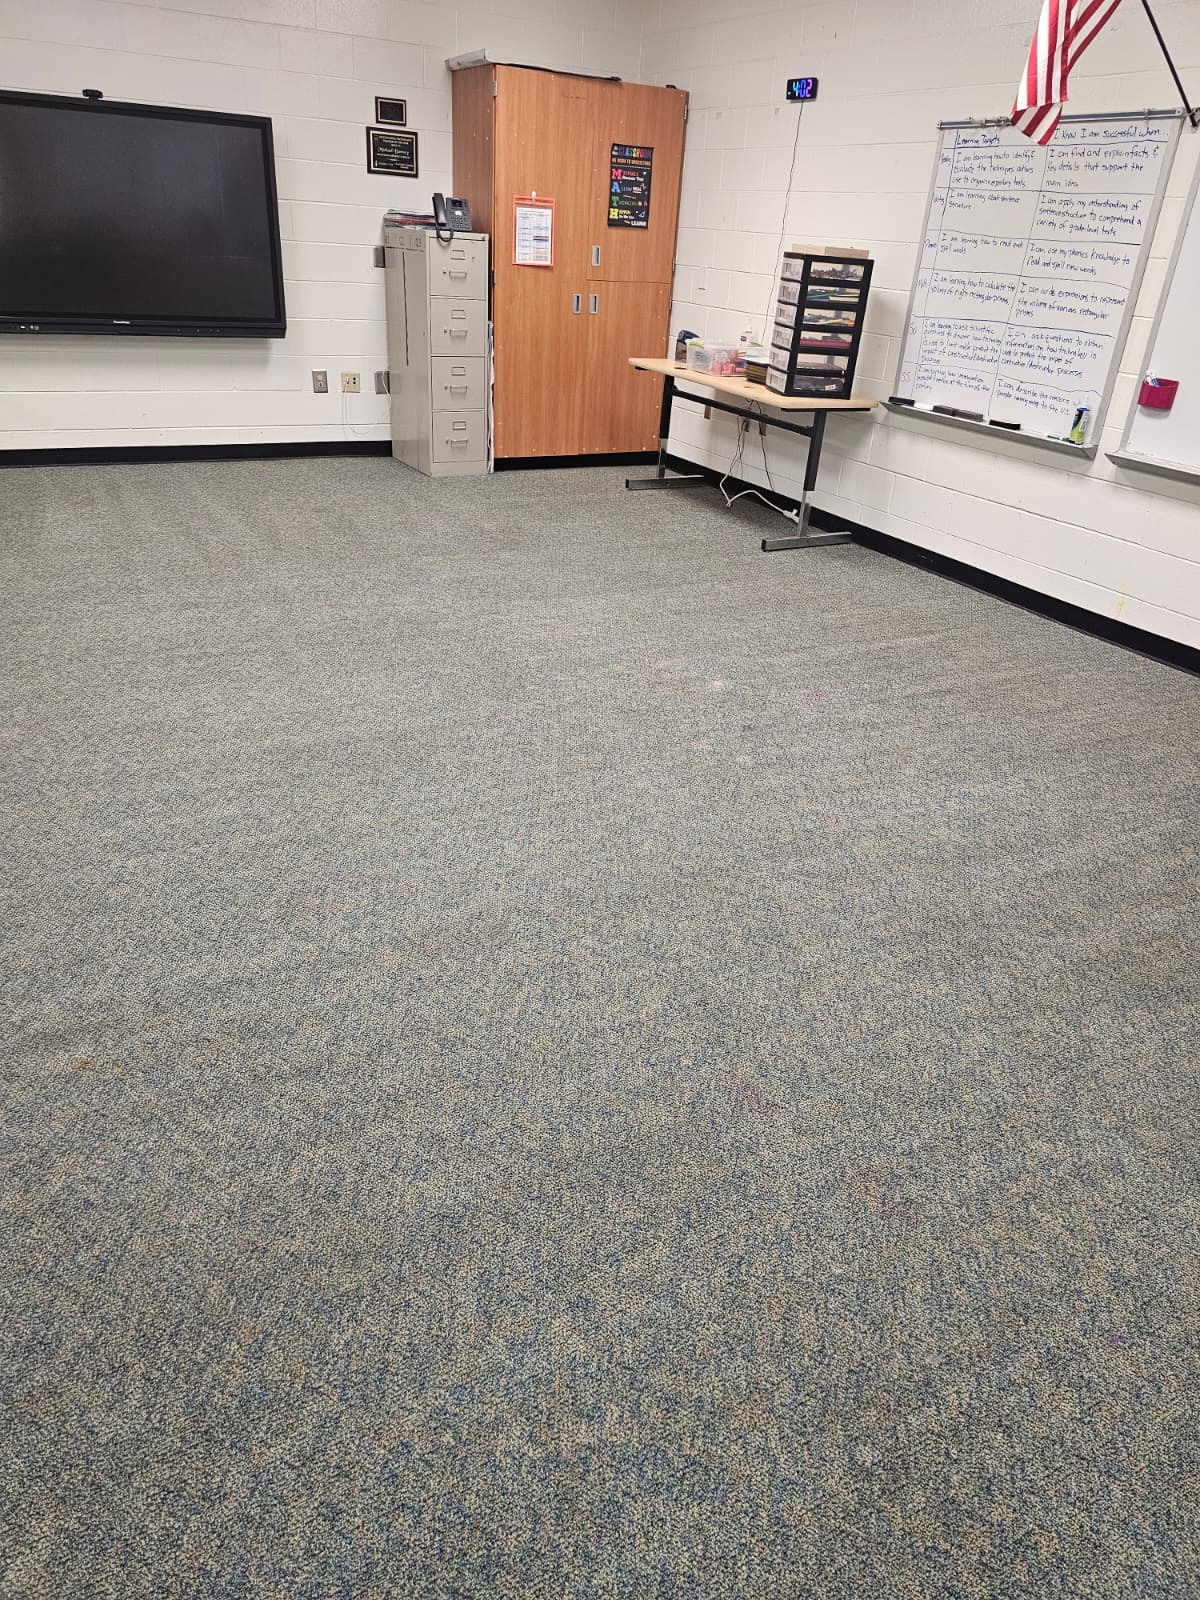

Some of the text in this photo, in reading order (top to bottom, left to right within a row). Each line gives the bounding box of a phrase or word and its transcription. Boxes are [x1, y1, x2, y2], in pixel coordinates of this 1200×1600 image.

[793, 79, 812, 97] 4:02
[1062, 130, 1077, 139] know
[1081, 128, 1086, 138] I
[1103, 126, 1137, 138] successful
[956, 152, 961, 163] I
[1050, 149, 1055, 157] I
[1071, 148, 1085, 157] find
[1087, 148, 1101, 157] and
[1085, 163, 1098, 171] that
[1102, 163, 1128, 173] support
[1131, 163, 1143, 171] the
[950, 190, 955, 198] I
[967, 190, 986, 203] learning
[1041, 195, 1046, 203] I
[1131, 200, 1141, 210] of
[942, 233, 947, 241] I
[1030, 243, 1035, 252] I
